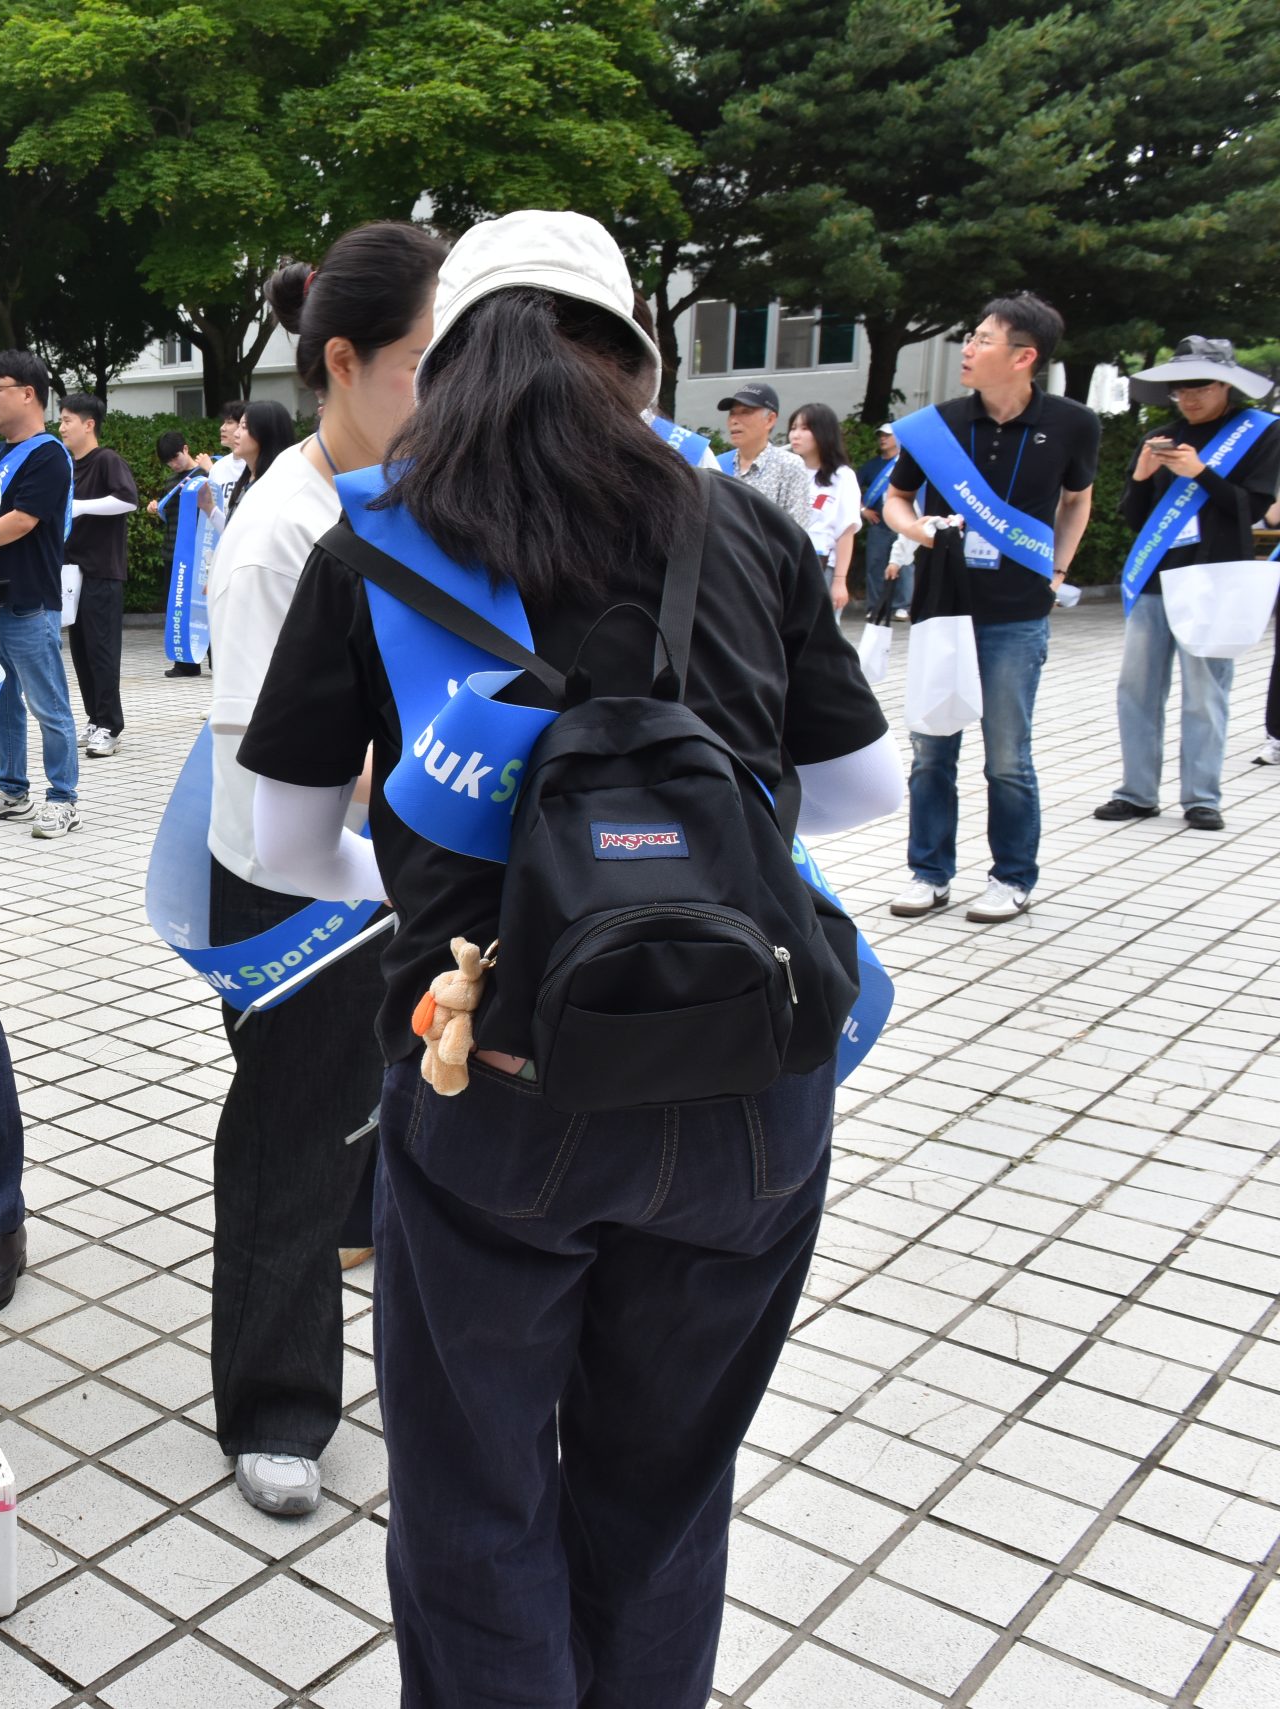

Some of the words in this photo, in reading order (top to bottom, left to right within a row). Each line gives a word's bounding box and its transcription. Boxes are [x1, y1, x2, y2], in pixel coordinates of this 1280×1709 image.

[1206, 419, 1255, 468] Jeonbuk
[953, 480, 1010, 534] Jeonbuk
[175, 562, 187, 608] Jeonbuk
[173, 610, 183, 645] Sports
[600, 831, 680, 850] JANSPORT
[238, 913, 345, 986] Sports
